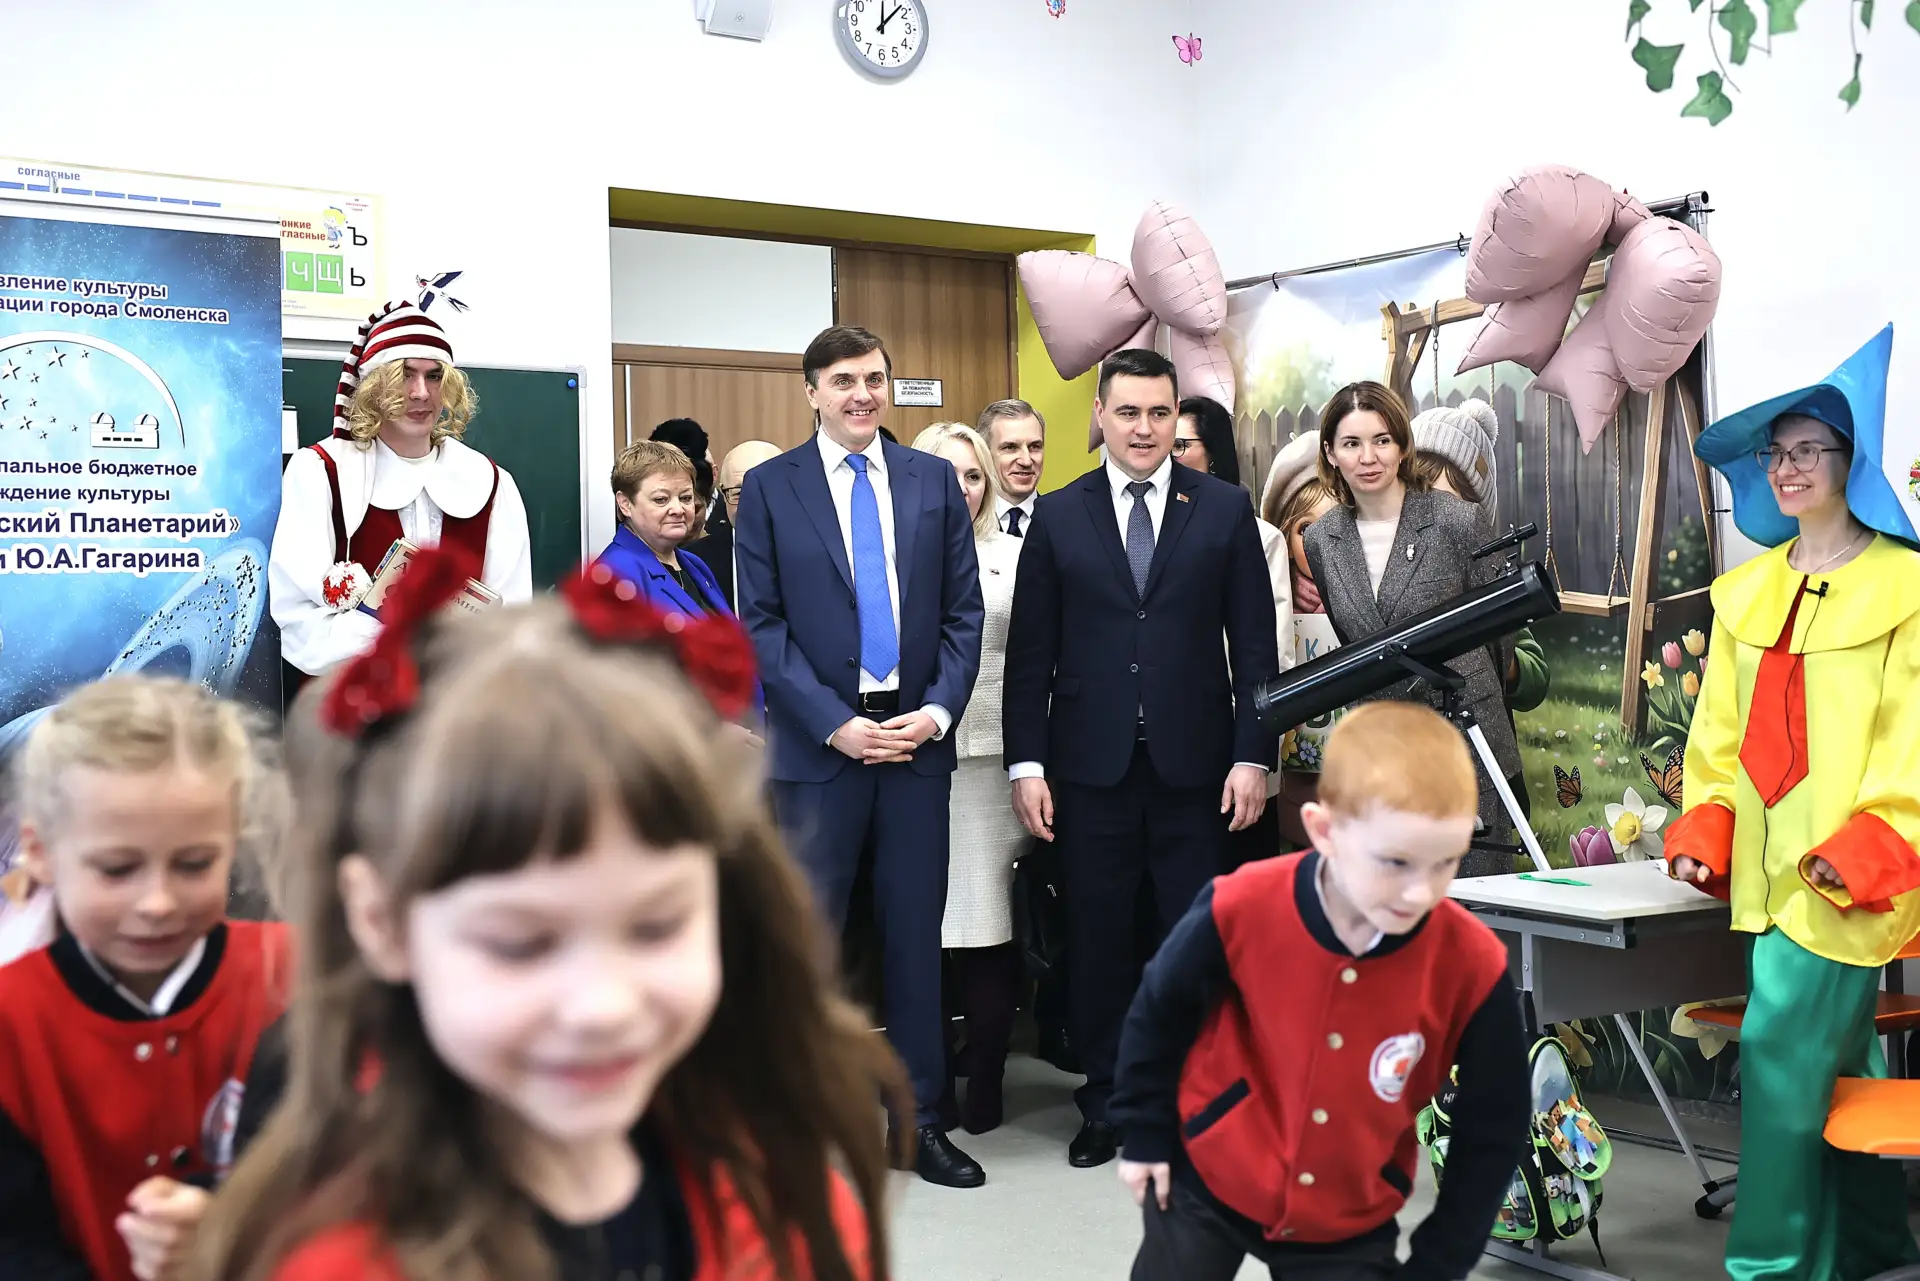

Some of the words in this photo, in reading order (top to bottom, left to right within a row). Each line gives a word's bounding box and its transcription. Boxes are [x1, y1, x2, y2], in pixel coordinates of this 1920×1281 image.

[853, 0, 864, 12] 10
[901, 8, 908, 19] 2
[851, 14, 858, 26] 9
[905, 22, 912, 34] 3
[854, 30, 861, 42] 8
[865, 43, 872, 54] 7
[901, 38, 908, 49] 4
[879, 49, 885, 60] 6
[891, 47, 898, 58] 5
[17, 167, 81, 181] согласные
[280, 230, 326, 241] гласные
[292, 261, 308, 281] Ч
[73, 281, 166, 299] культуры
[50, 301, 118, 317] города
[124, 302, 227, 323] Смоленска
[89, 460, 197, 477] бюджетное
[77, 488, 170, 504] культуры
[0, 512, 60, 533] ский
[70, 512, 240, 538] Планетарий»
[17, 548, 200, 573] Ю.А.Гагарина
